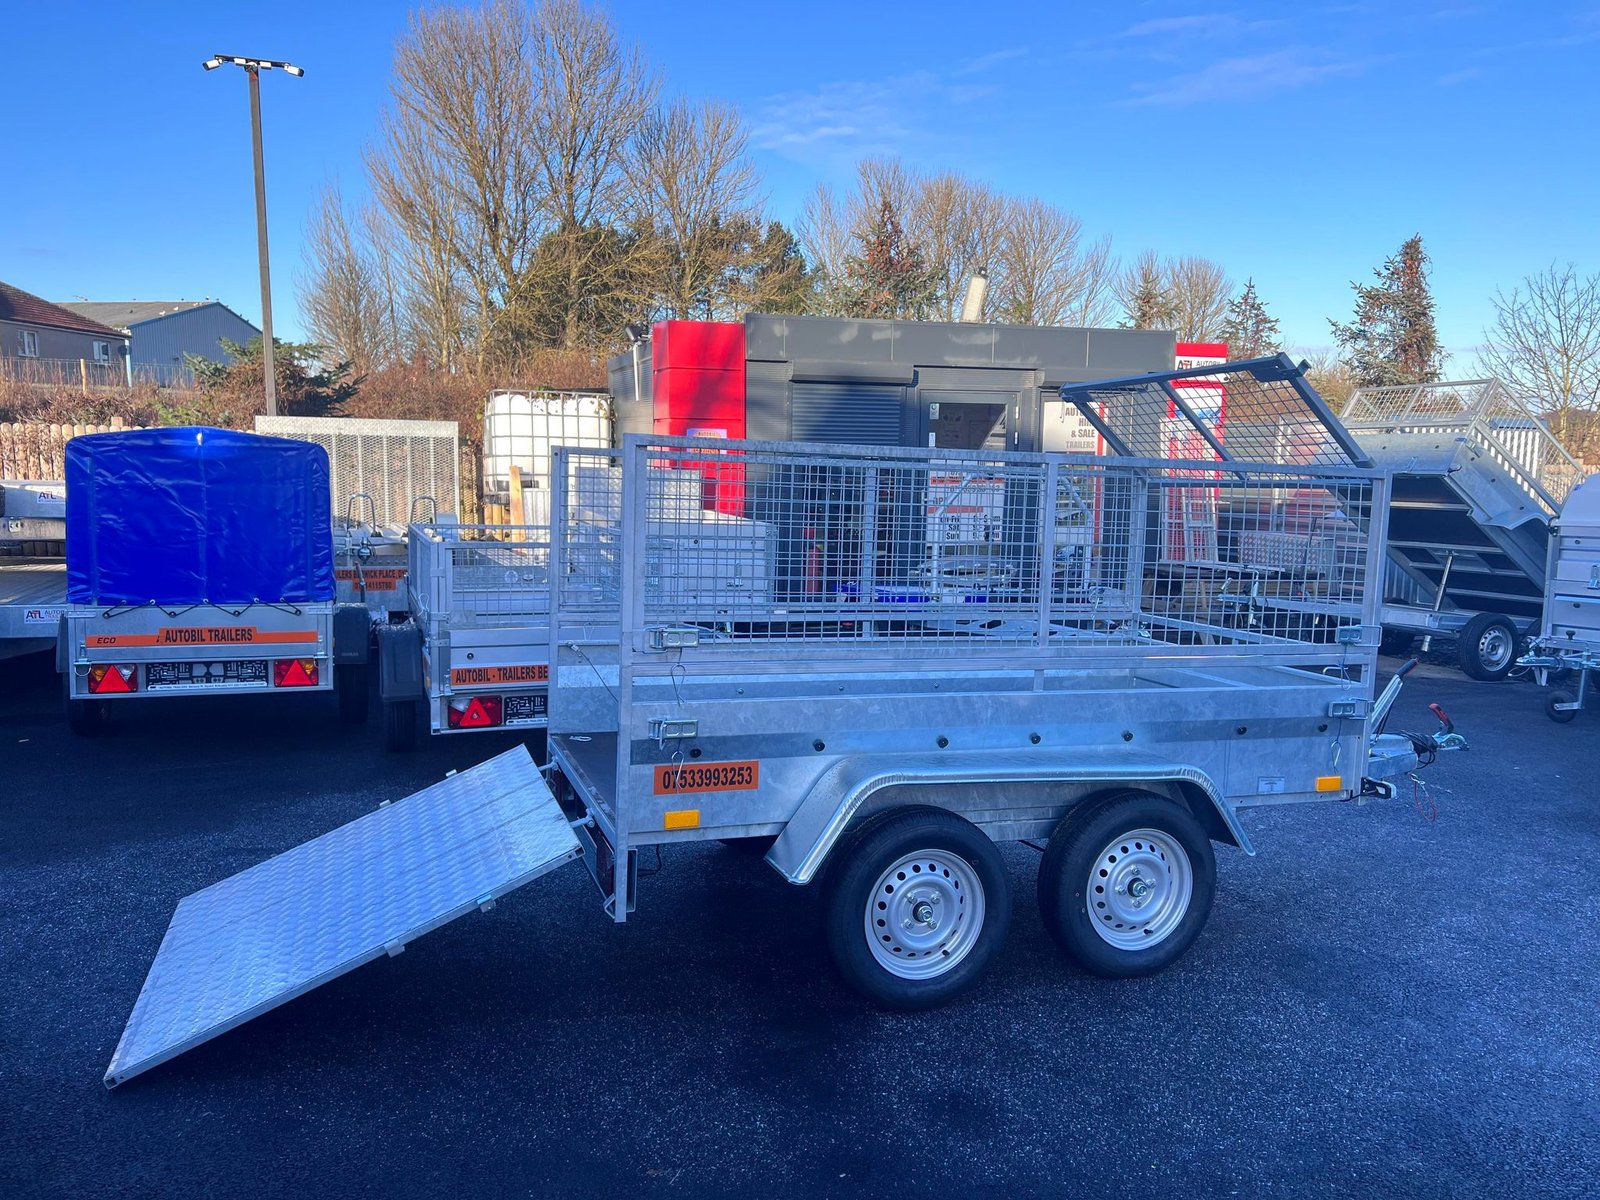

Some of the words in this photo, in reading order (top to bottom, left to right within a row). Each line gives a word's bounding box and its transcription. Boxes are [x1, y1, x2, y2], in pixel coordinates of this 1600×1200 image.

[1071, 430, 1076, 438] &
[1078, 429, 1095, 438] SALE
[1066, 441, 1095, 449] TRAILERS
[25, 610, 44, 619] ATL
[96, 636, 116, 645] ECO
[164, 629, 206, 644] AUTOBIL
[208, 628, 253, 642] TRAILERS
[456, 669, 491, 683] AUTOBIL
[498, 667, 536, 681] TRAILERS
[662, 766, 753, 790] 07533993253
